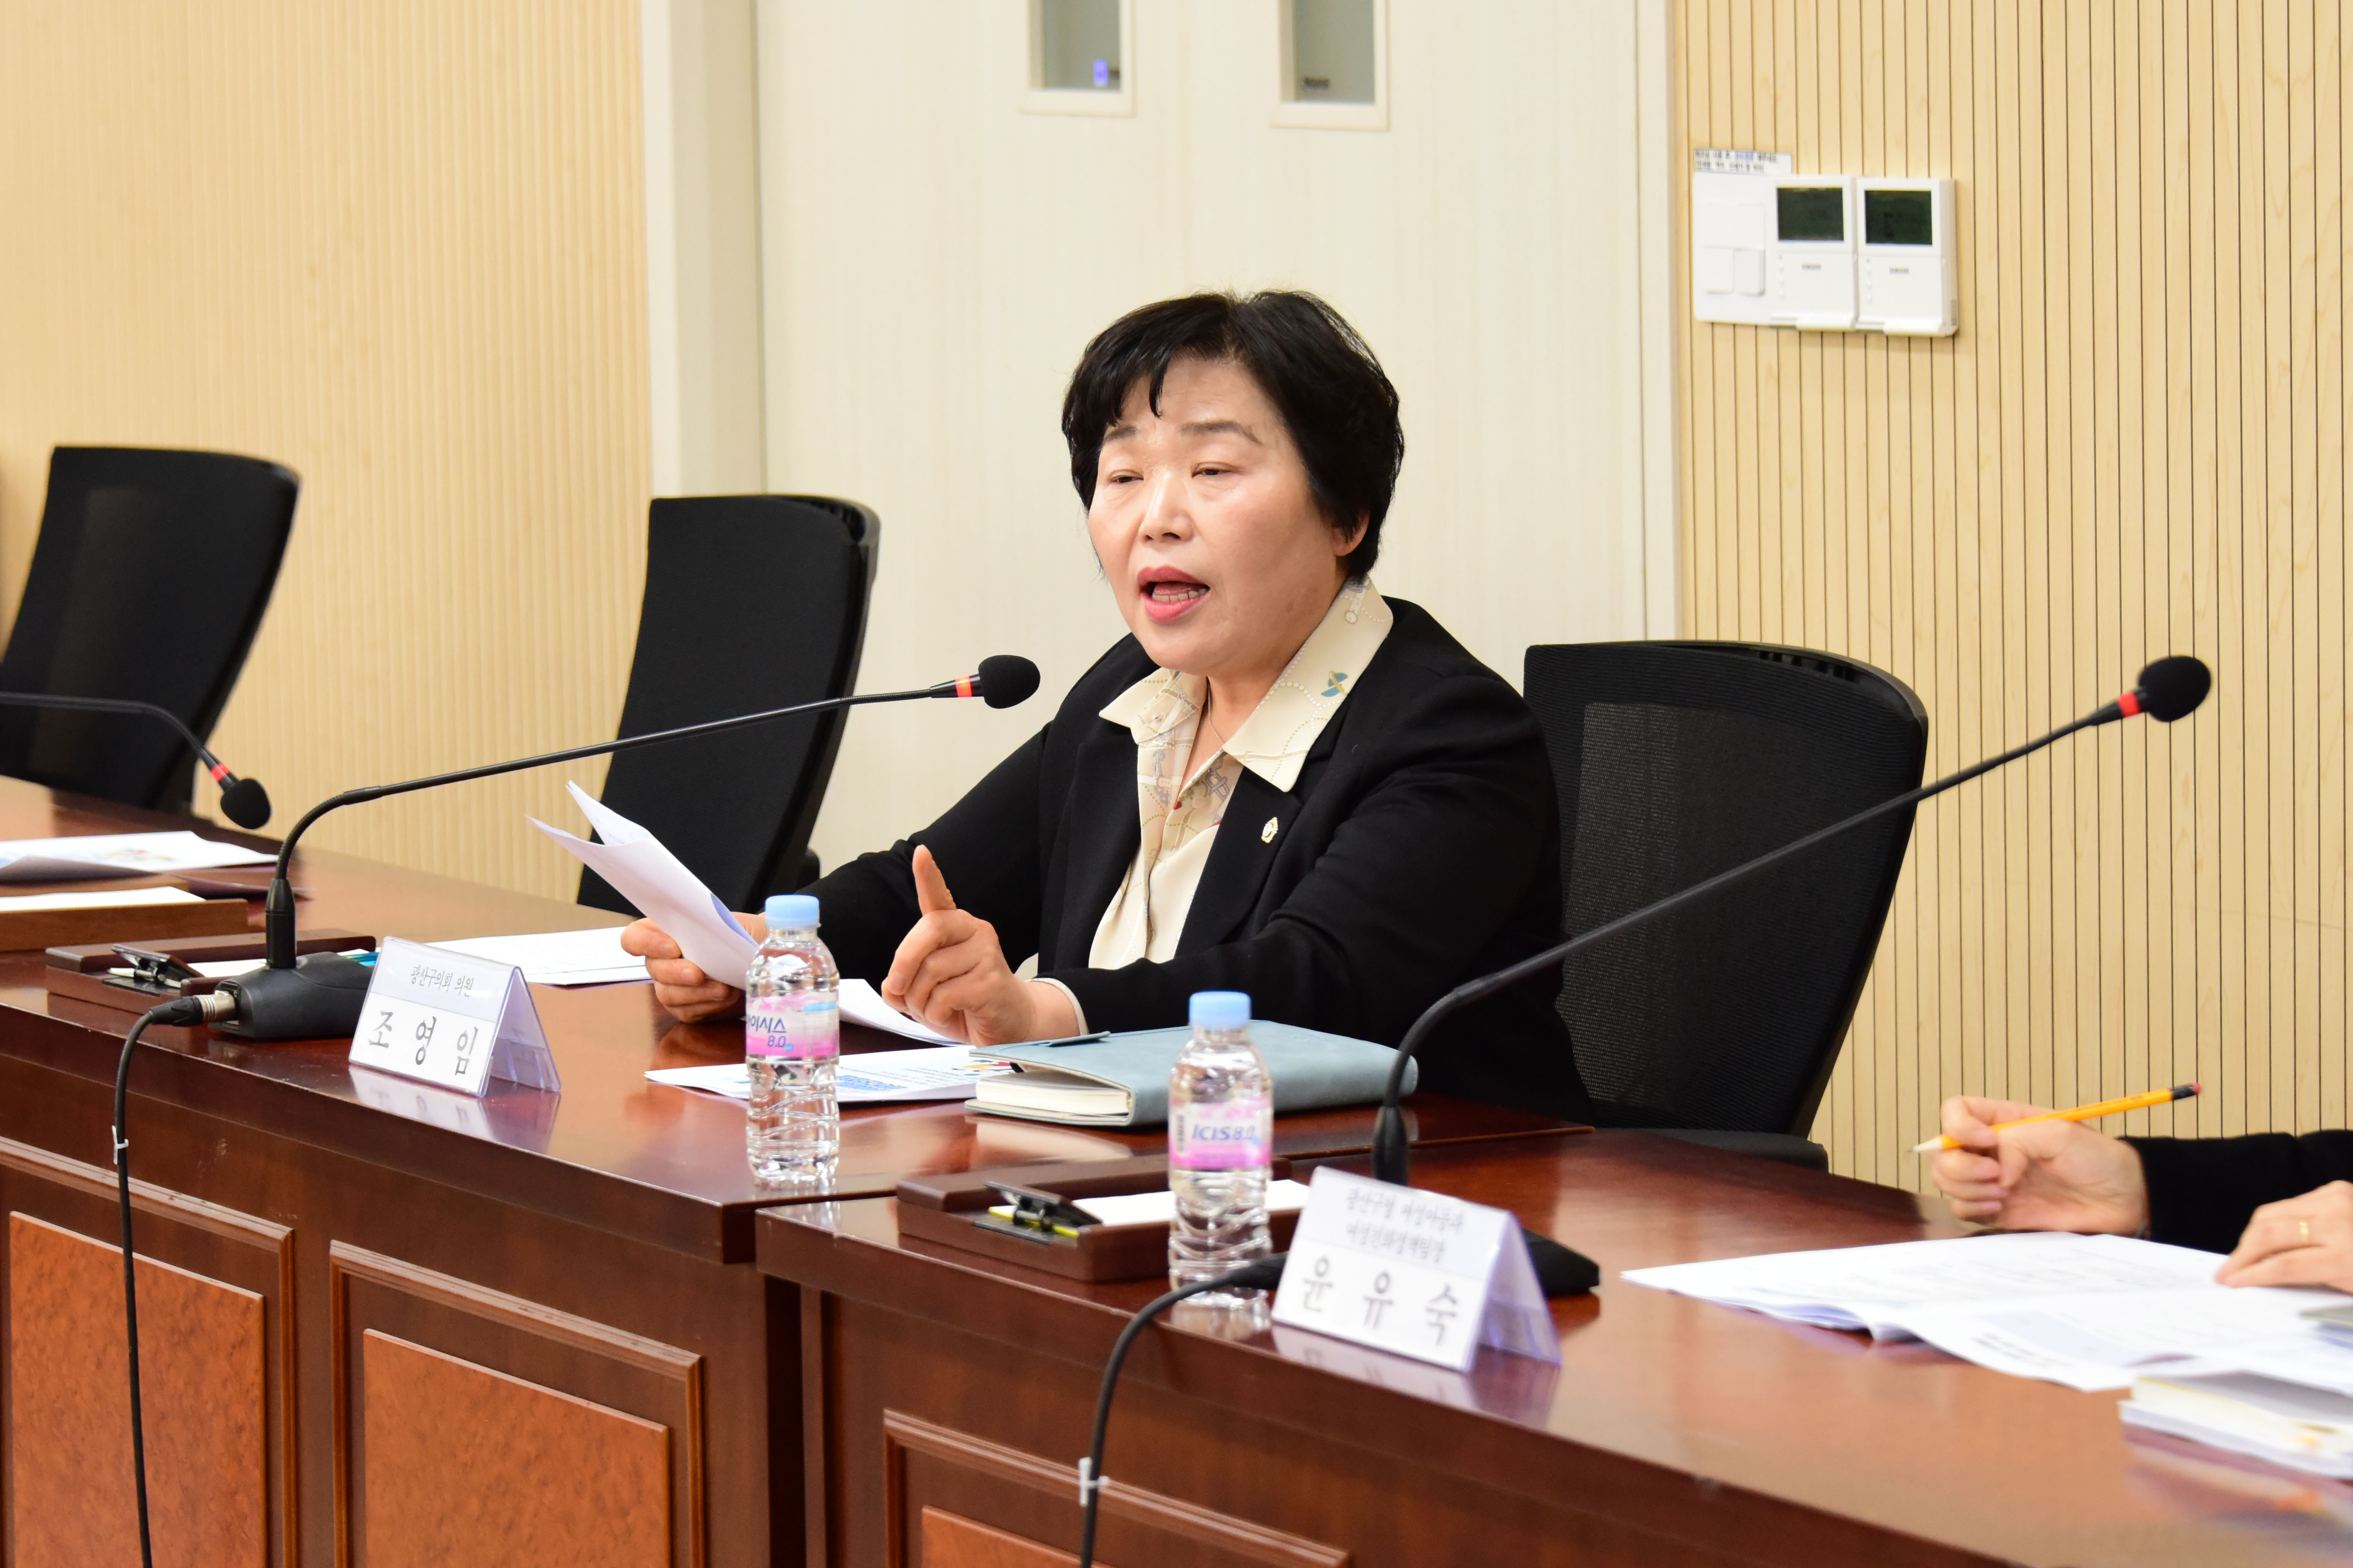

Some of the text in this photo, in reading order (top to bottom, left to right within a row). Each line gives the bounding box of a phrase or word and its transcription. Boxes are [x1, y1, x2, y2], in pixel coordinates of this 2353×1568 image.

[411, 964, 474, 998] 광산구의회 의원
[767, 1035, 786, 1048] 8.0
